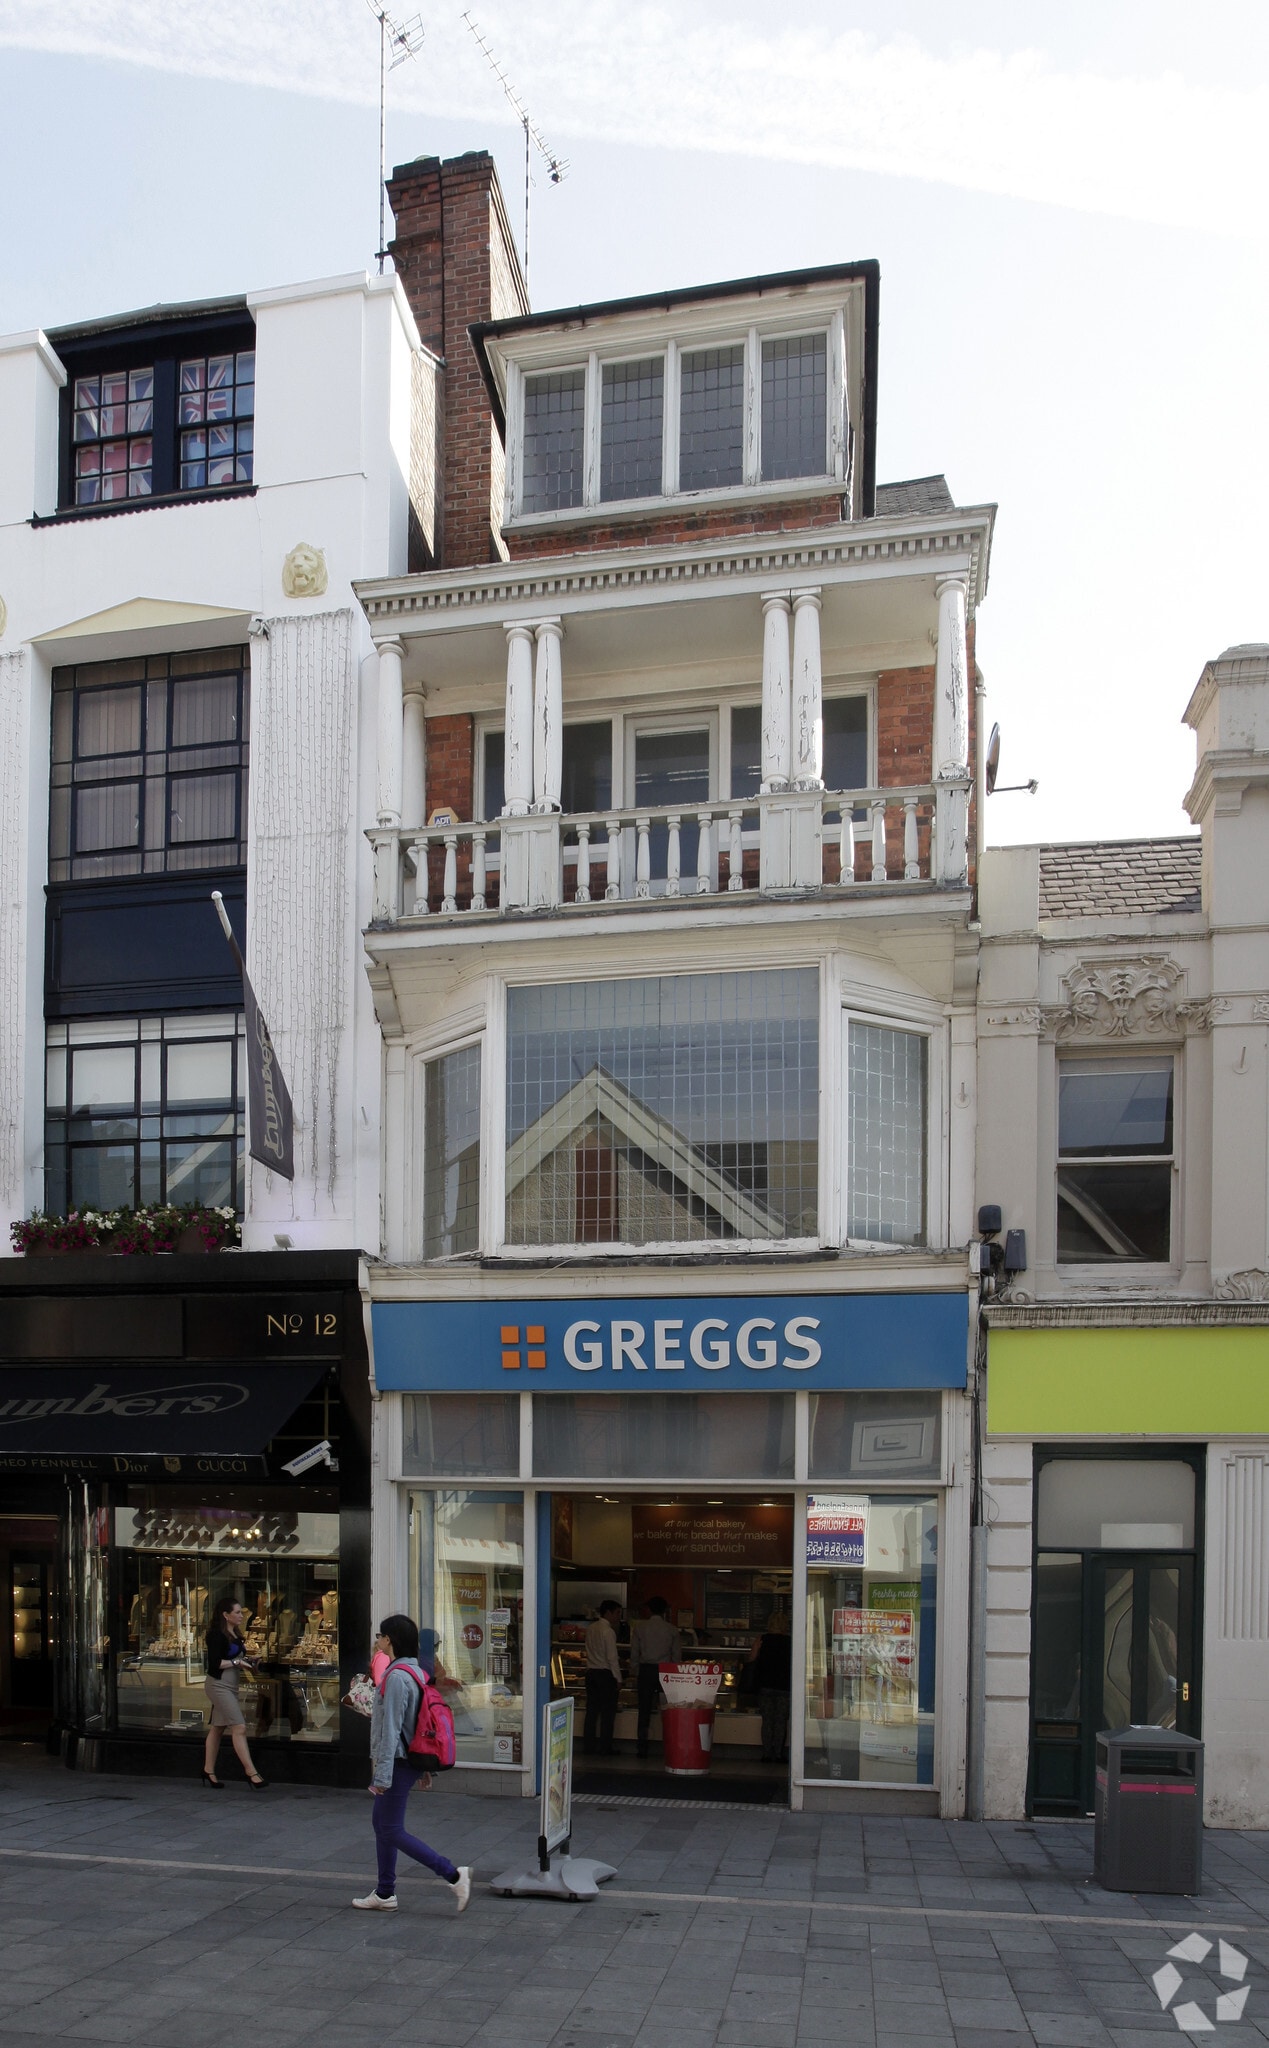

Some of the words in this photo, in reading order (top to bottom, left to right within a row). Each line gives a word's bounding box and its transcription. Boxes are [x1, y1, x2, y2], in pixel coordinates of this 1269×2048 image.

[435, 816, 450, 826] ADT
[260, 1015, 280, 1154] Lumber
[315, 1314, 337, 1336] 12
[563, 1317, 822, 1371] GREGGS
[31, 1459, 98, 1469] FENNELL
[113, 1456, 150, 1473] Dior
[196, 1459, 248, 1473] GUCCI
[676, 1520, 691, 1528] our
[694, 1519, 713, 1528] local
[716, 1519, 746, 1530] bakery
[647, 1530, 671, 1539] bake
[674, 1530, 688, 1539] the
[691, 1530, 720, 1540] bread
[744, 1531, 778, 1541] makes
[665, 1544, 689, 1554] your
[690, 1542, 746, 1553] sandwich
[465, 1578, 483, 1587] BEAN
[459, 1588, 482, 1599] Melt
[872, 1588, 897, 1600] freshly
[897, 1588, 919, 1598] made
[677, 1664, 709, 1674] WOW
[663, 1674, 669, 1684] 4
[694, 1675, 702, 1685] 3
